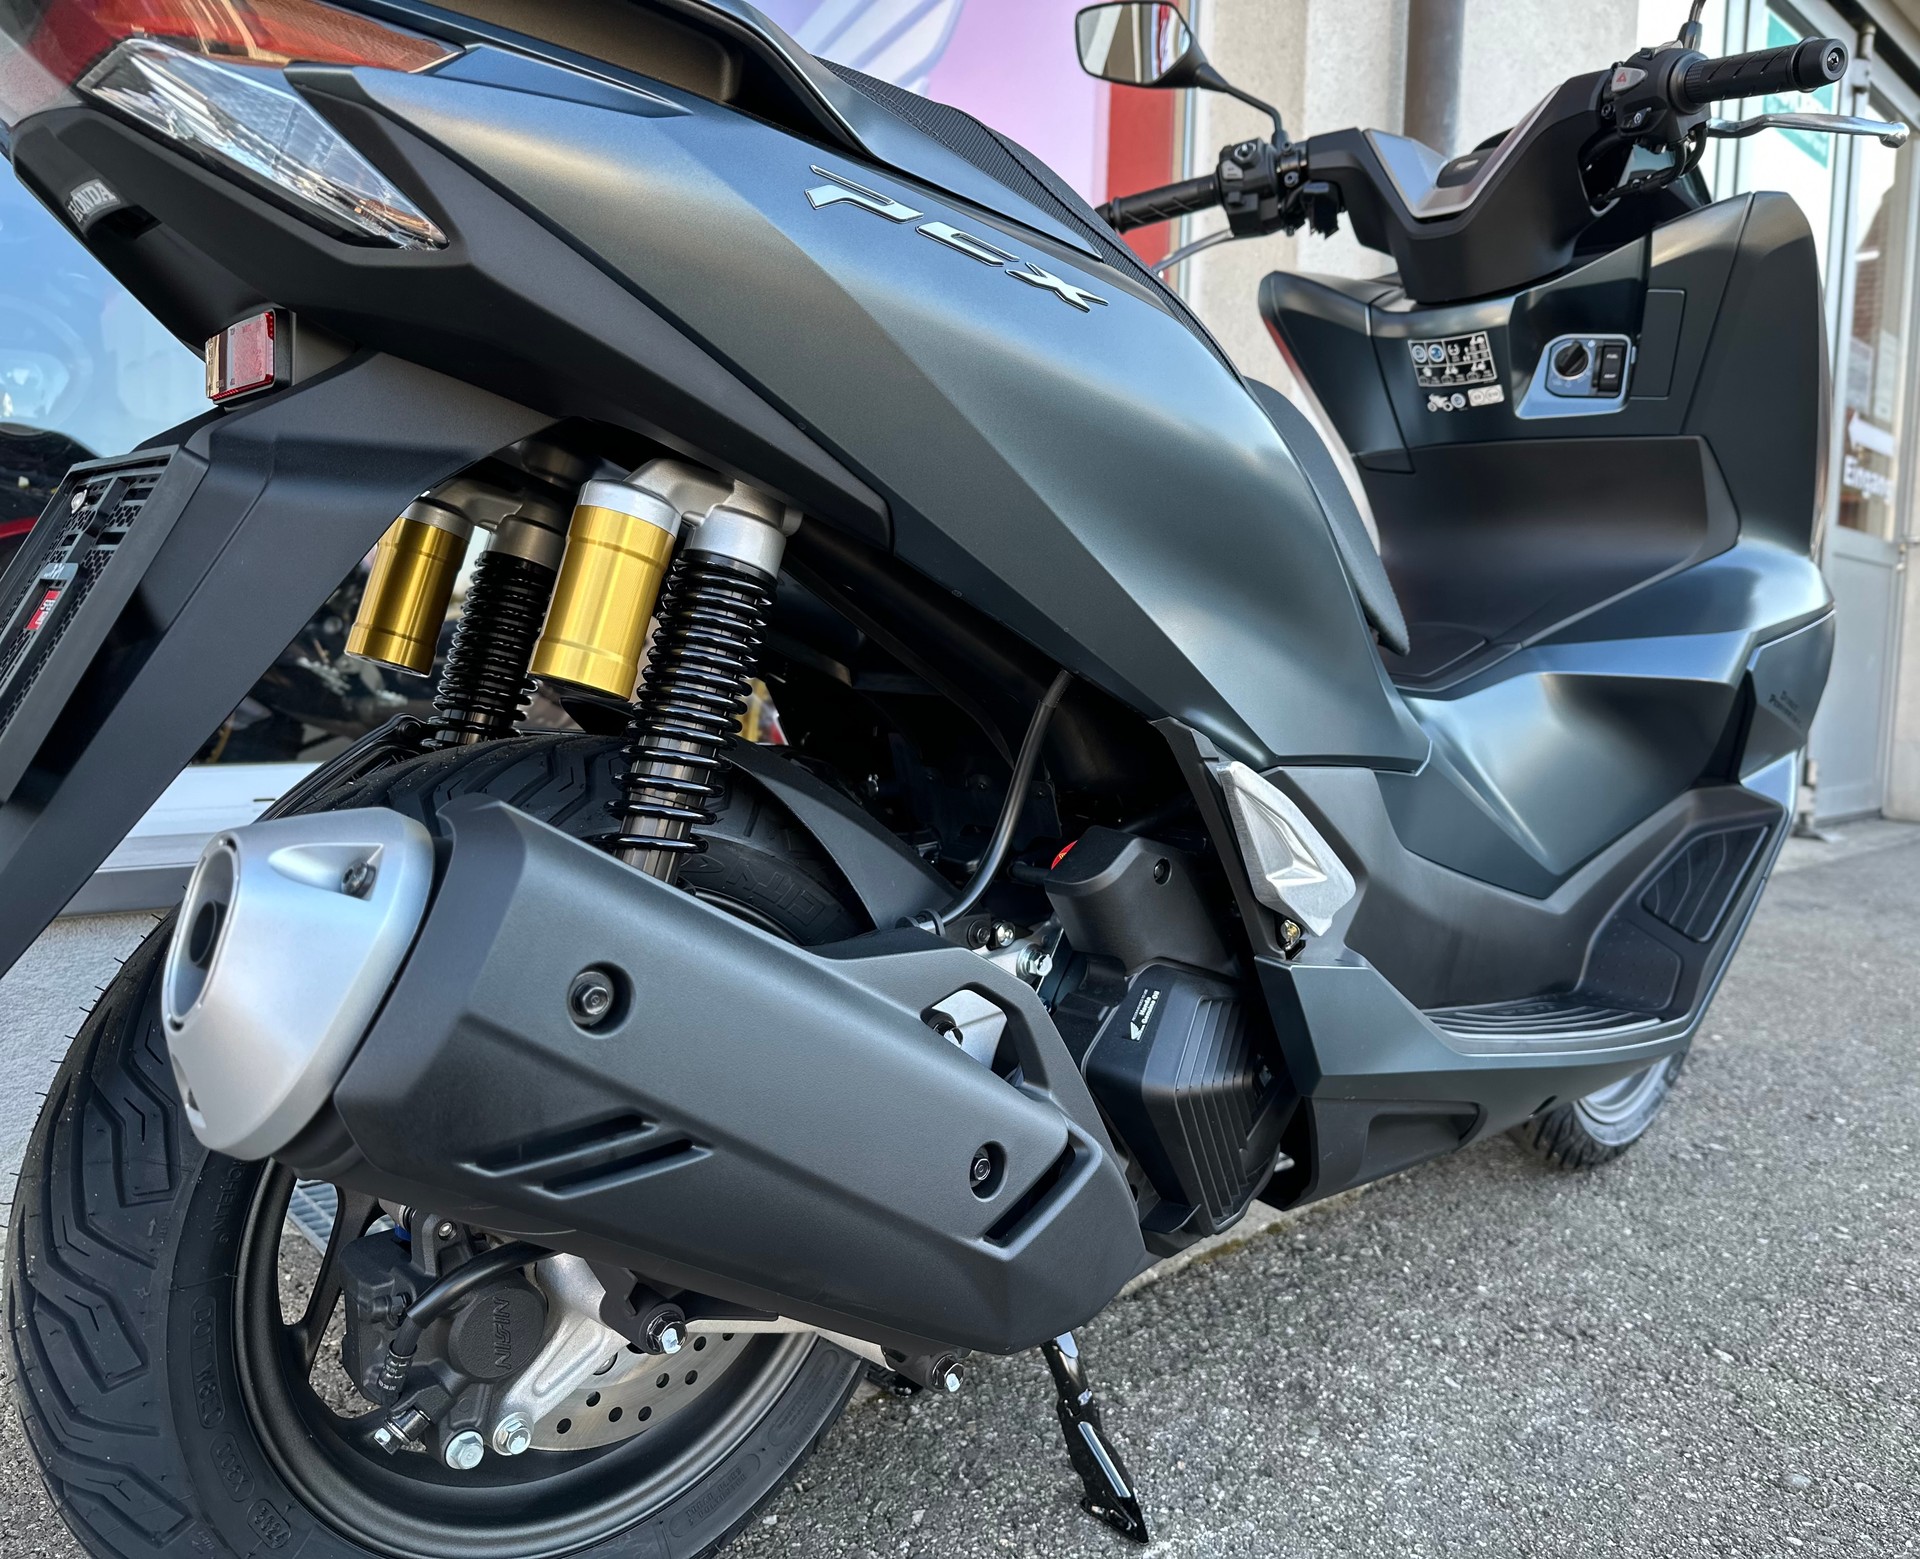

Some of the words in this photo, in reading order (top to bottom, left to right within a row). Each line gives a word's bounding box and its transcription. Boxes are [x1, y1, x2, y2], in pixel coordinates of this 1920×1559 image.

[67, 182, 118, 223] HONDA
[804, 163, 1110, 313] PCX
[1139, 996, 1151, 1015] Honda
[193, 1303, 213, 1352] DOT
